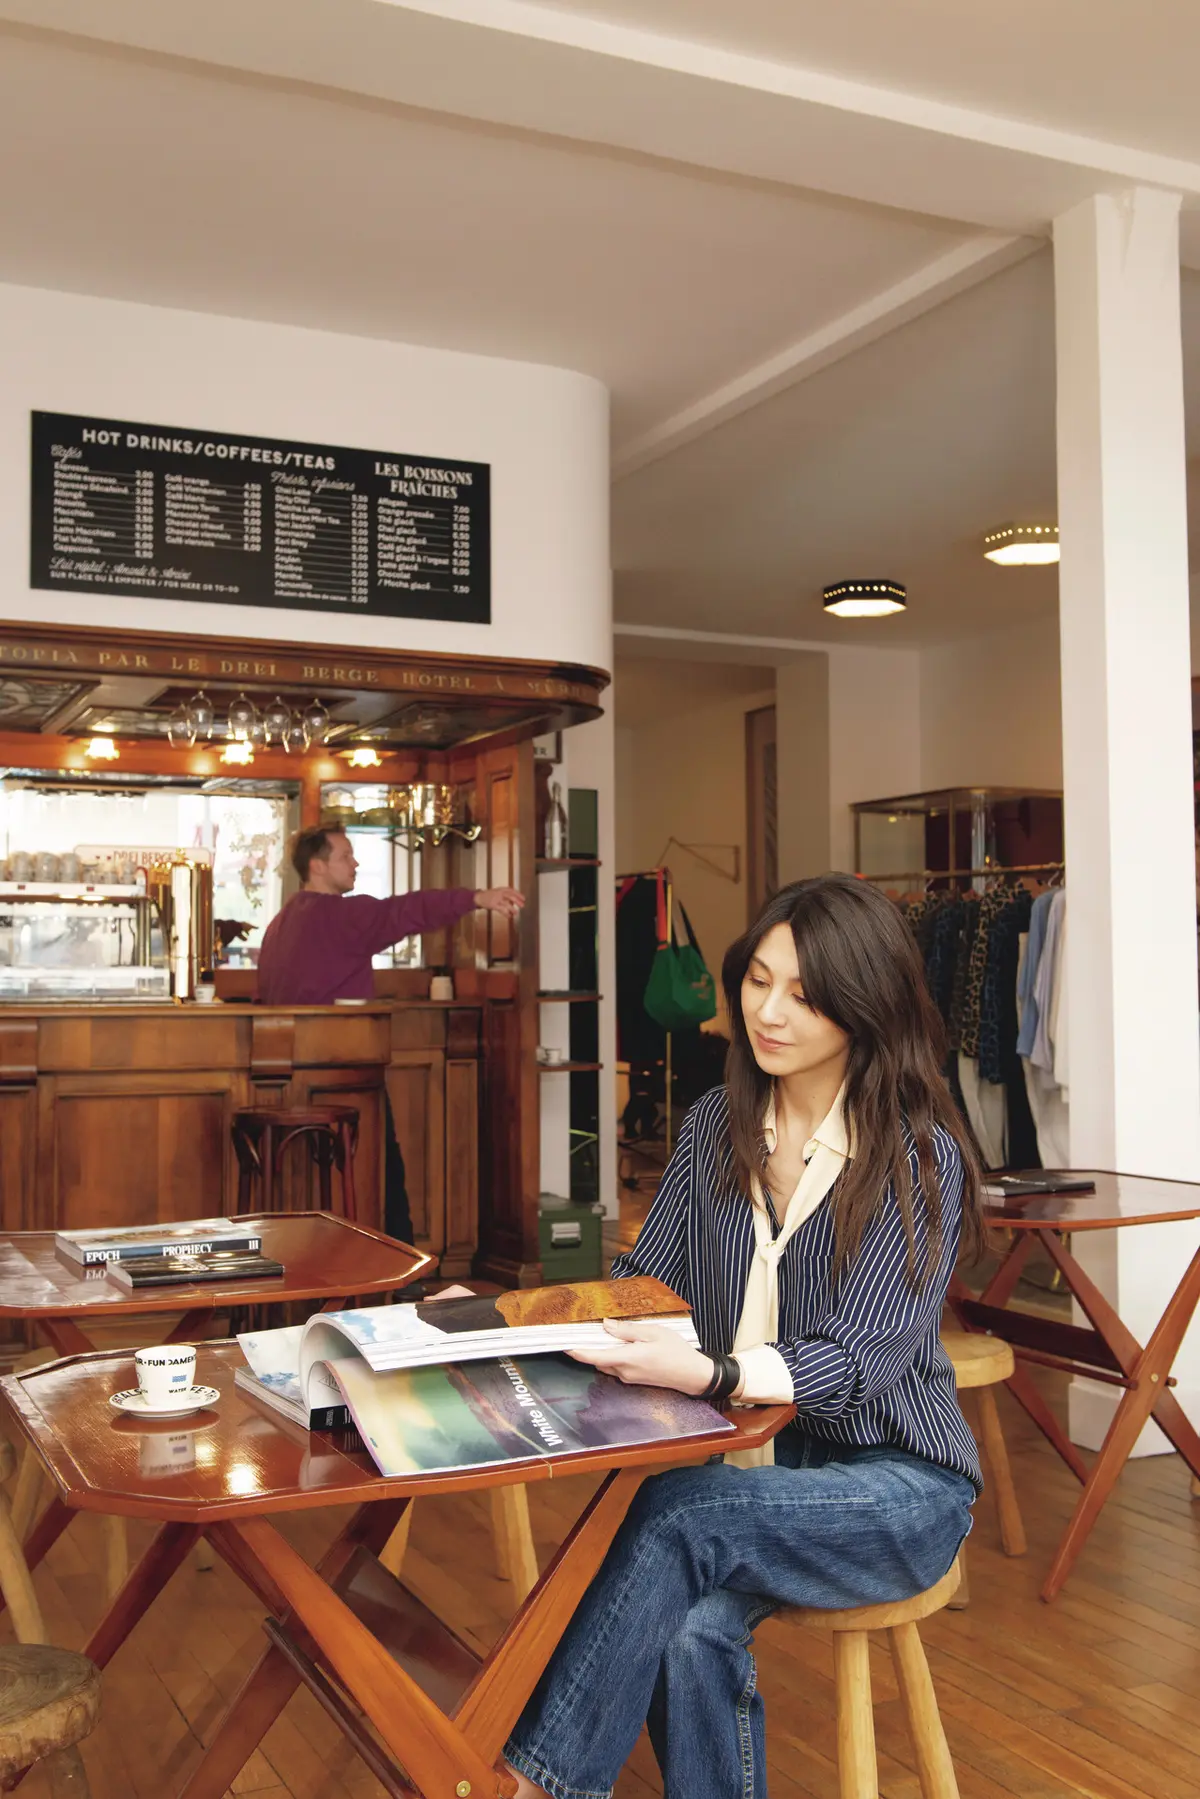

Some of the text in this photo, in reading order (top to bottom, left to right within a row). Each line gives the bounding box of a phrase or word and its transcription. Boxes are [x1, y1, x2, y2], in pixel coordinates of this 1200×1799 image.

[82, 429, 335, 470] HOT DRINKS/COFFEES/TEAS
[165, 473, 182, 482] Café
[375, 461, 472, 485] LES BOISSONS
[293, 487, 311, 496] Latte
[391, 477, 457, 498] FRAÎCHES
[378, 508, 404, 516] Orange
[165, 519, 199, 528] Chocolat
[165, 528, 199, 536] Chocolat
[70, 536, 93, 544] White
[378, 561, 396, 569] Latte
[99, 651, 149, 668] PAR
[171, 657, 200, 671] LE
[220, 660, 277, 676] DREI
[302, 666, 379, 682] BERGE
[402, 672, 476, 689] HOTEL
[162, 1243, 213, 1257] PROPHECY
[86, 1250, 120, 1263] EPOCH
[529, 1409, 564, 1447] White
